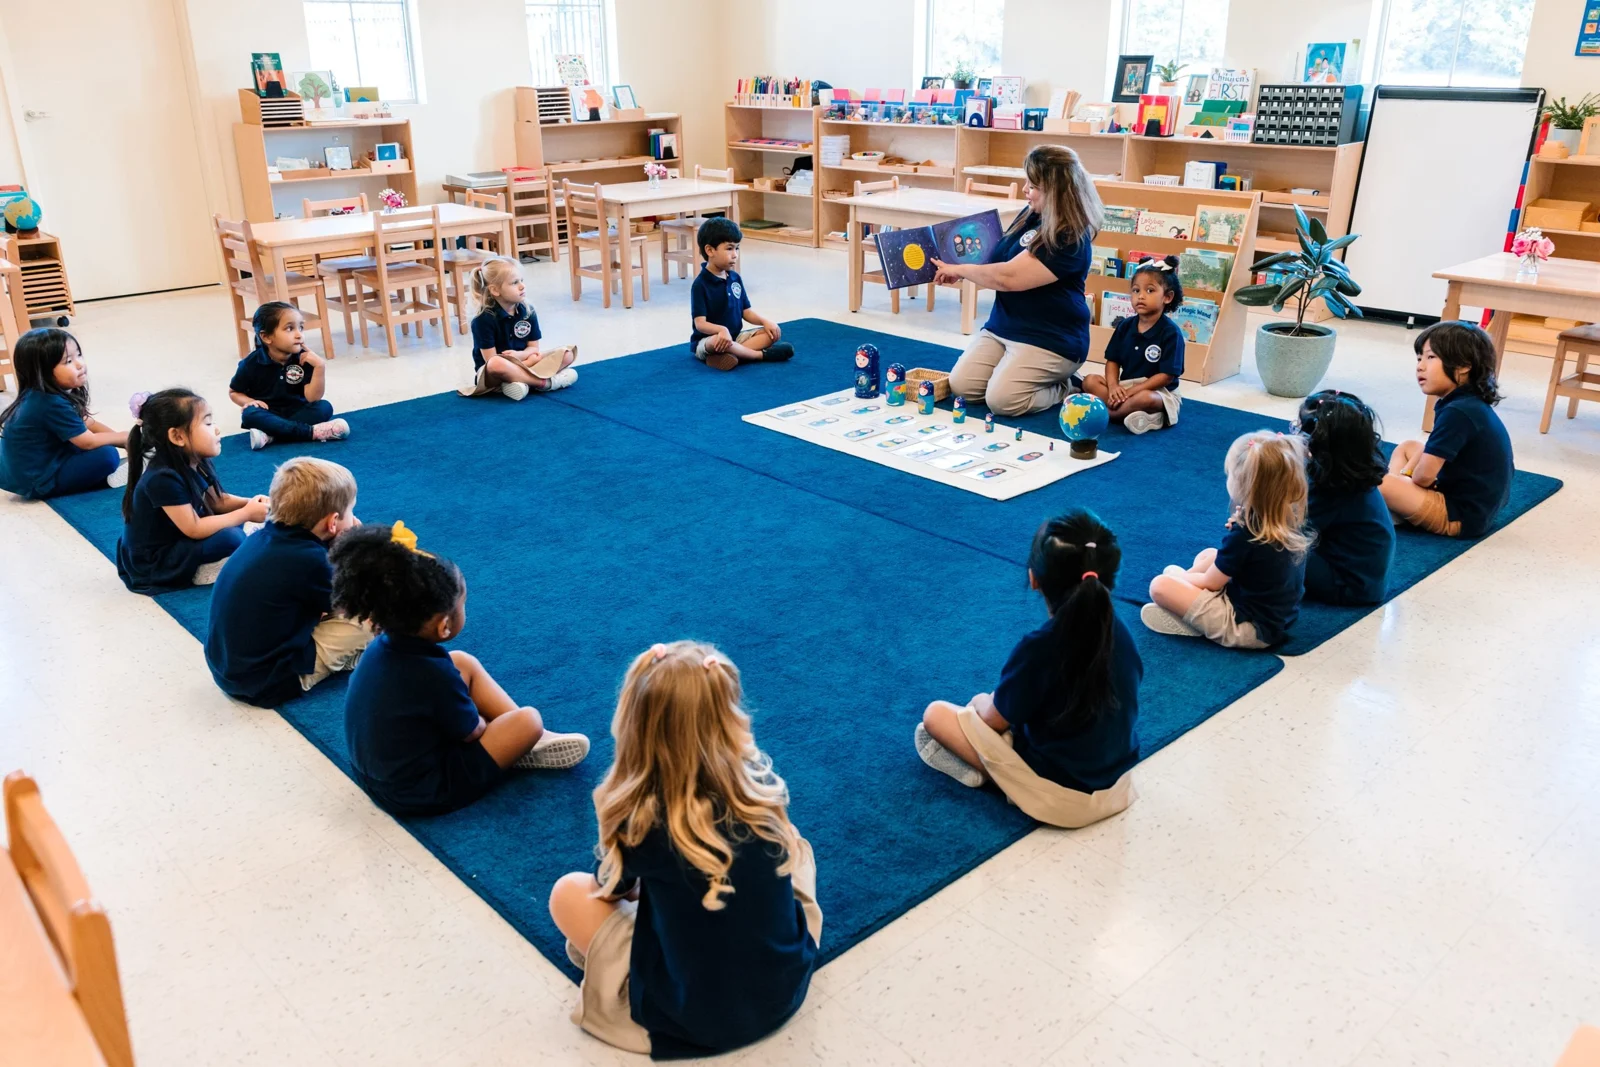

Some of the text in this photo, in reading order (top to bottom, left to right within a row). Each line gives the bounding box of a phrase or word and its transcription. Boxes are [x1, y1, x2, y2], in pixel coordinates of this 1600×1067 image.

[1208, 82, 1250, 99] FIRST
[1182, 307, 1196, 315] Magic
[1197, 309, 1212, 319] Wand
